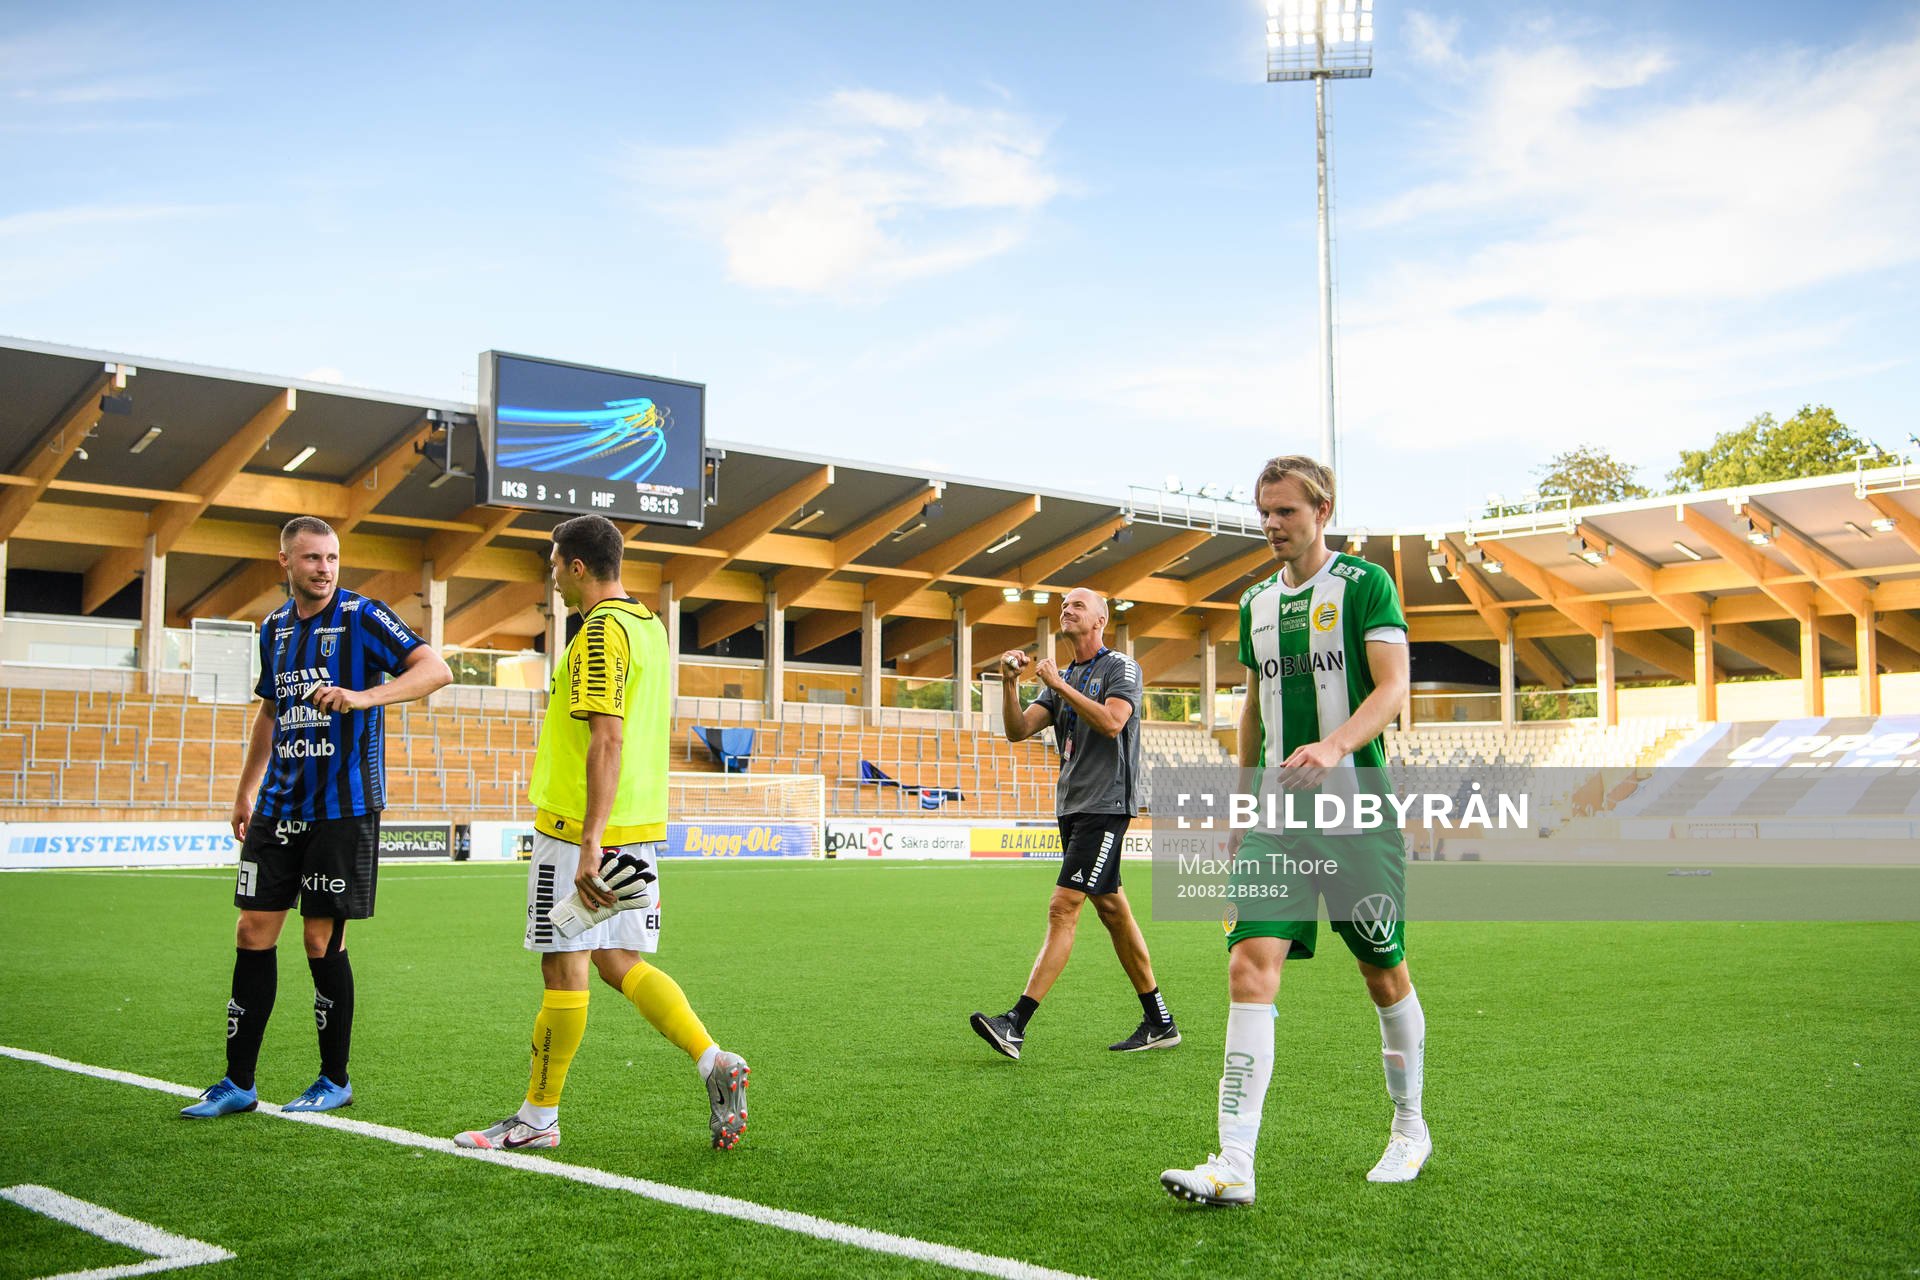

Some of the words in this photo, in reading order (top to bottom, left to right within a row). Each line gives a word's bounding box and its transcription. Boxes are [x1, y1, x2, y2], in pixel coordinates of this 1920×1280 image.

[502, 481, 527, 498] IKS
[537, 485, 546, 501] 3
[568, 489, 576, 504] 1
[591, 491, 616, 508] HIF
[640, 495, 679, 515] 95:13
[372, 608, 410, 643] stadium
[614, 657, 626, 709] stadium
[1727, 732, 1920, 760] UPPS
[50, 835, 236, 854] SYSTEMSVETS
[379, 841, 446, 851] PORTALEN
[684, 827, 782, 857] Bygg-Ole
[834, 831, 894, 850] DALOC
[901, 836, 928, 849] Säkra
[1162, 839, 1207, 853] HYREX
[302, 873, 346, 893] xite
[543, 1027, 553, 1052] Motor
[540, 1055, 550, 1090] Upplands
